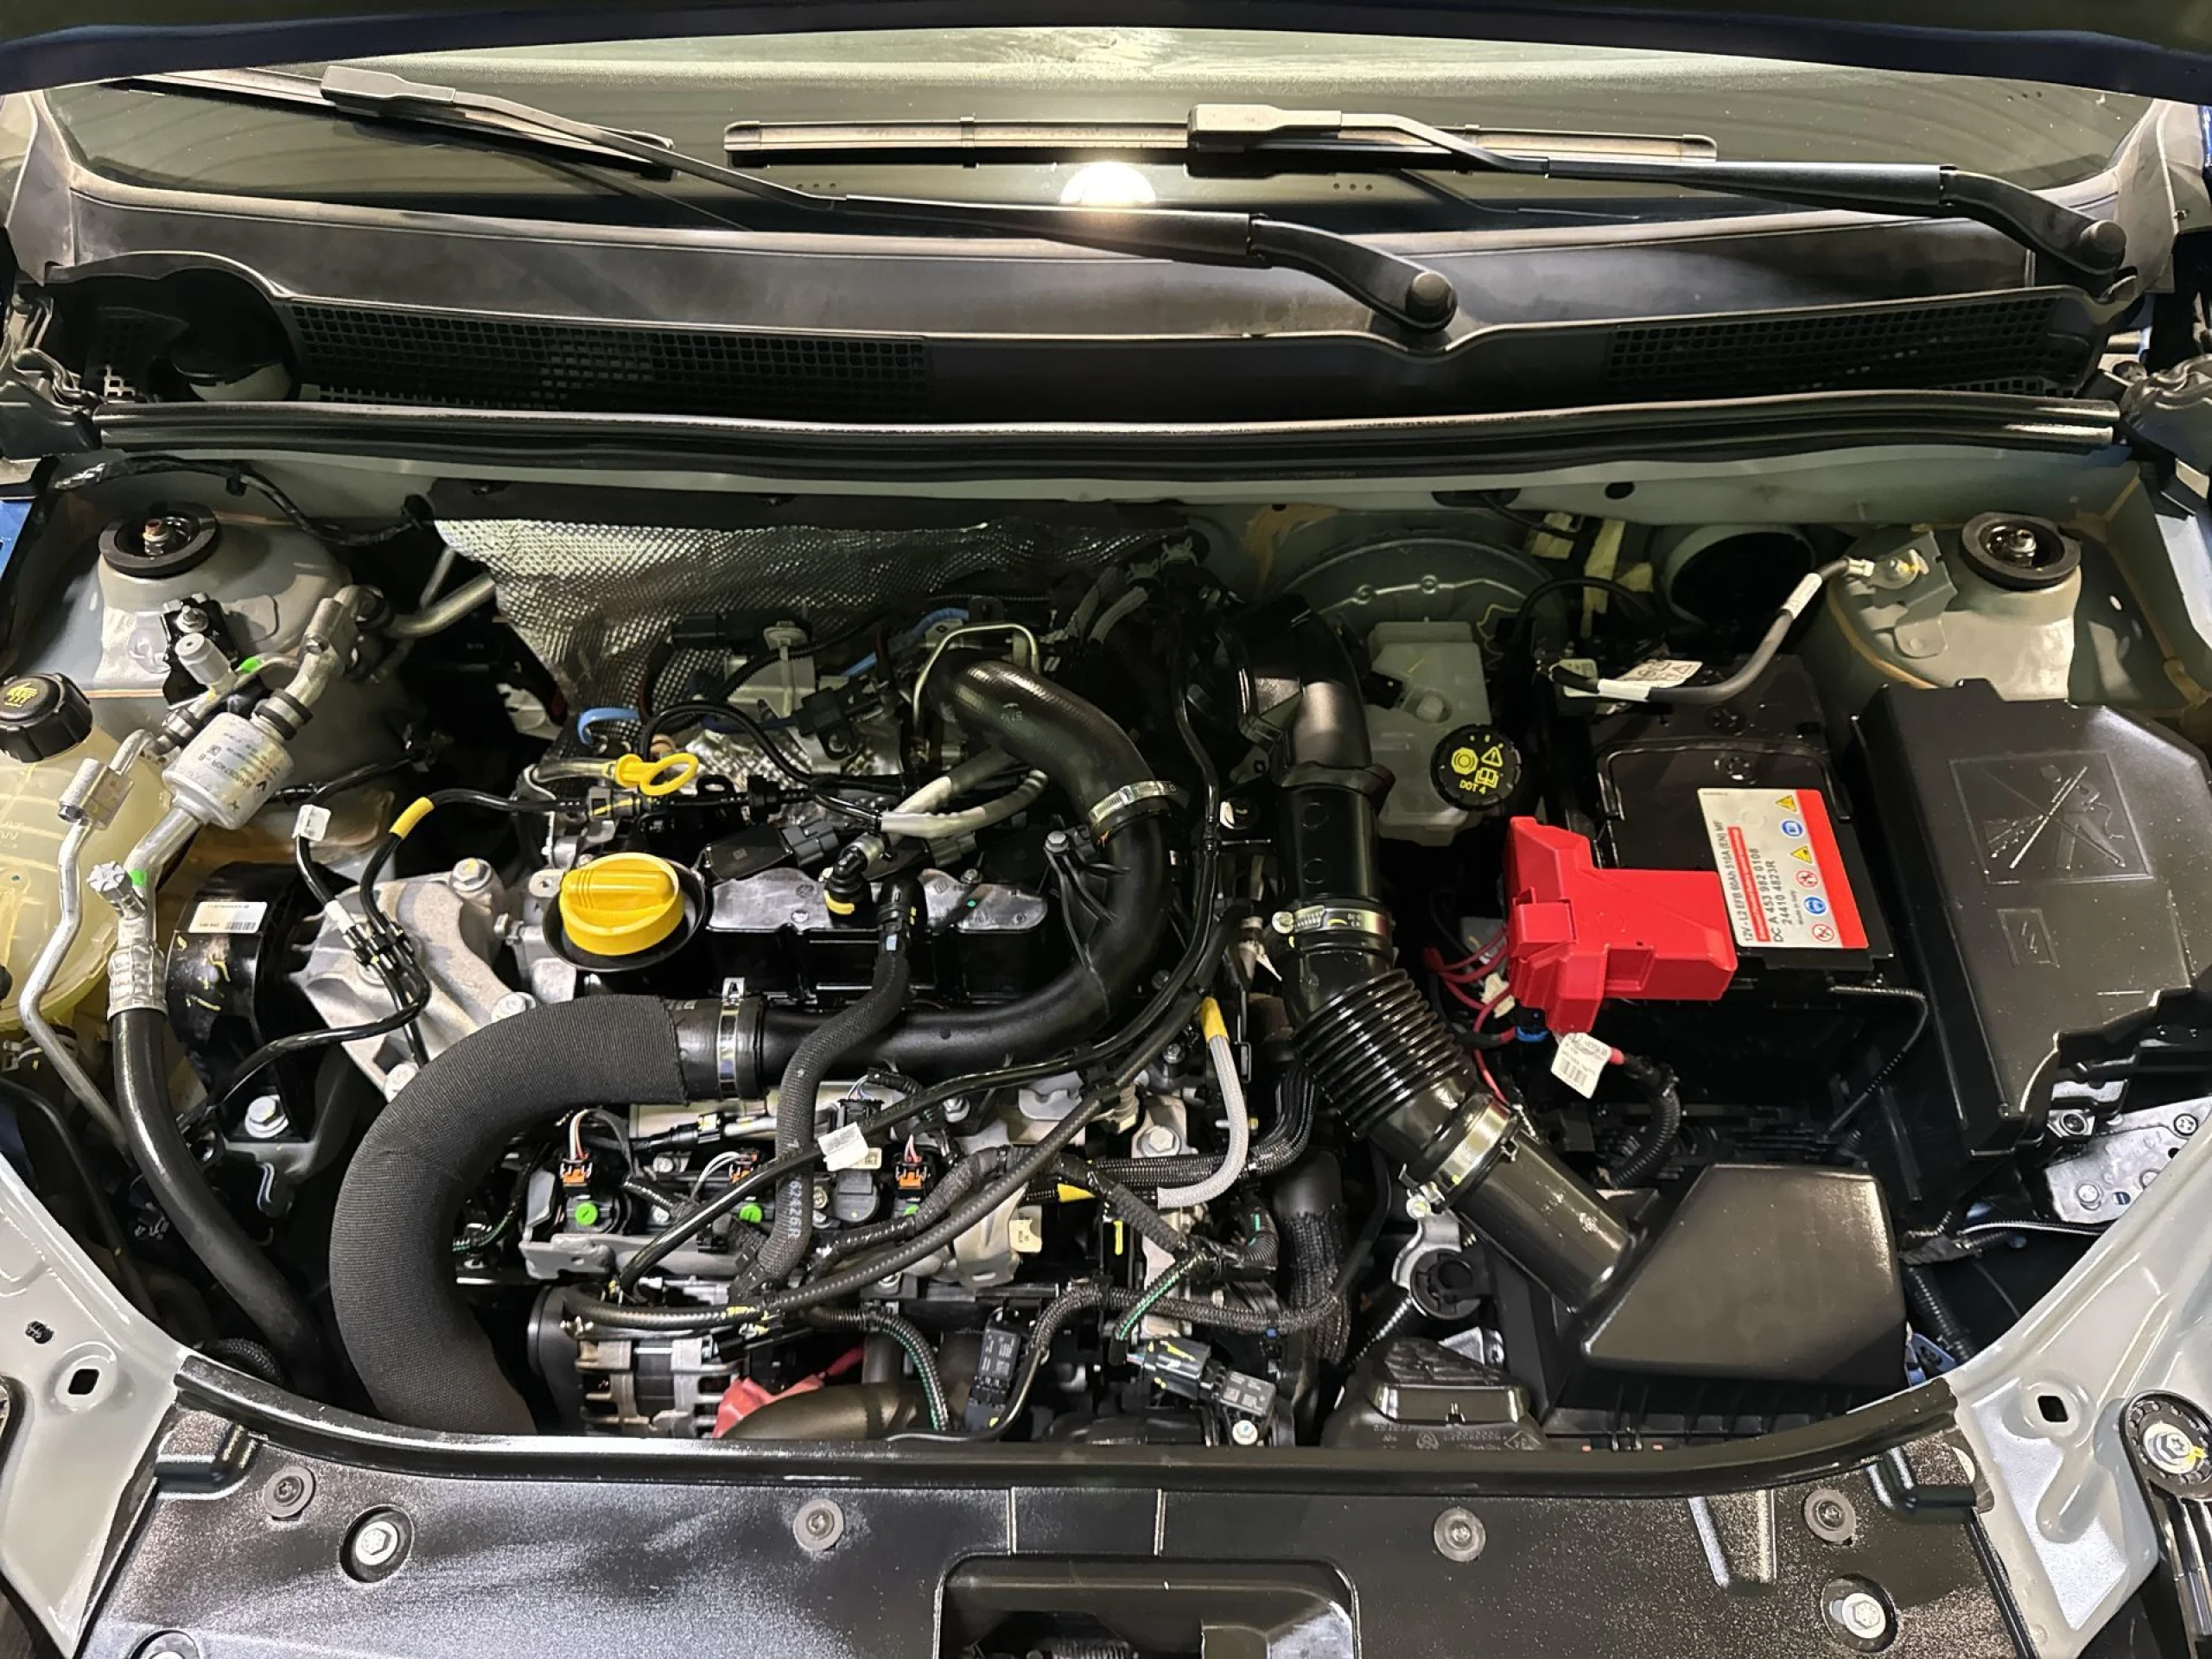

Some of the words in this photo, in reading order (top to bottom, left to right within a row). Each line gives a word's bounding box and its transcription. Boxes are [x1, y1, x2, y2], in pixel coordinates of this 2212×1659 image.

[1459, 780, 1478, 792] DOT
[1479, 786, 1486, 795] 4
[1713, 820, 1723, 830] MF
[1749, 849, 1764, 870] 0108
[1727, 872, 1739, 890] 60Ah
[1756, 874, 1770, 891] 982
[1765, 860, 1783, 892] 4823R
[1732, 893, 1744, 908] EFB
[1762, 895, 1776, 912] 453
[1738, 911, 1747, 920] L2
[1775, 894, 1792, 925] 24410
[1768, 916, 1778, 925] A
[1743, 927, 1753, 941] 12V
[1772, 928, 1783, 942] DC
